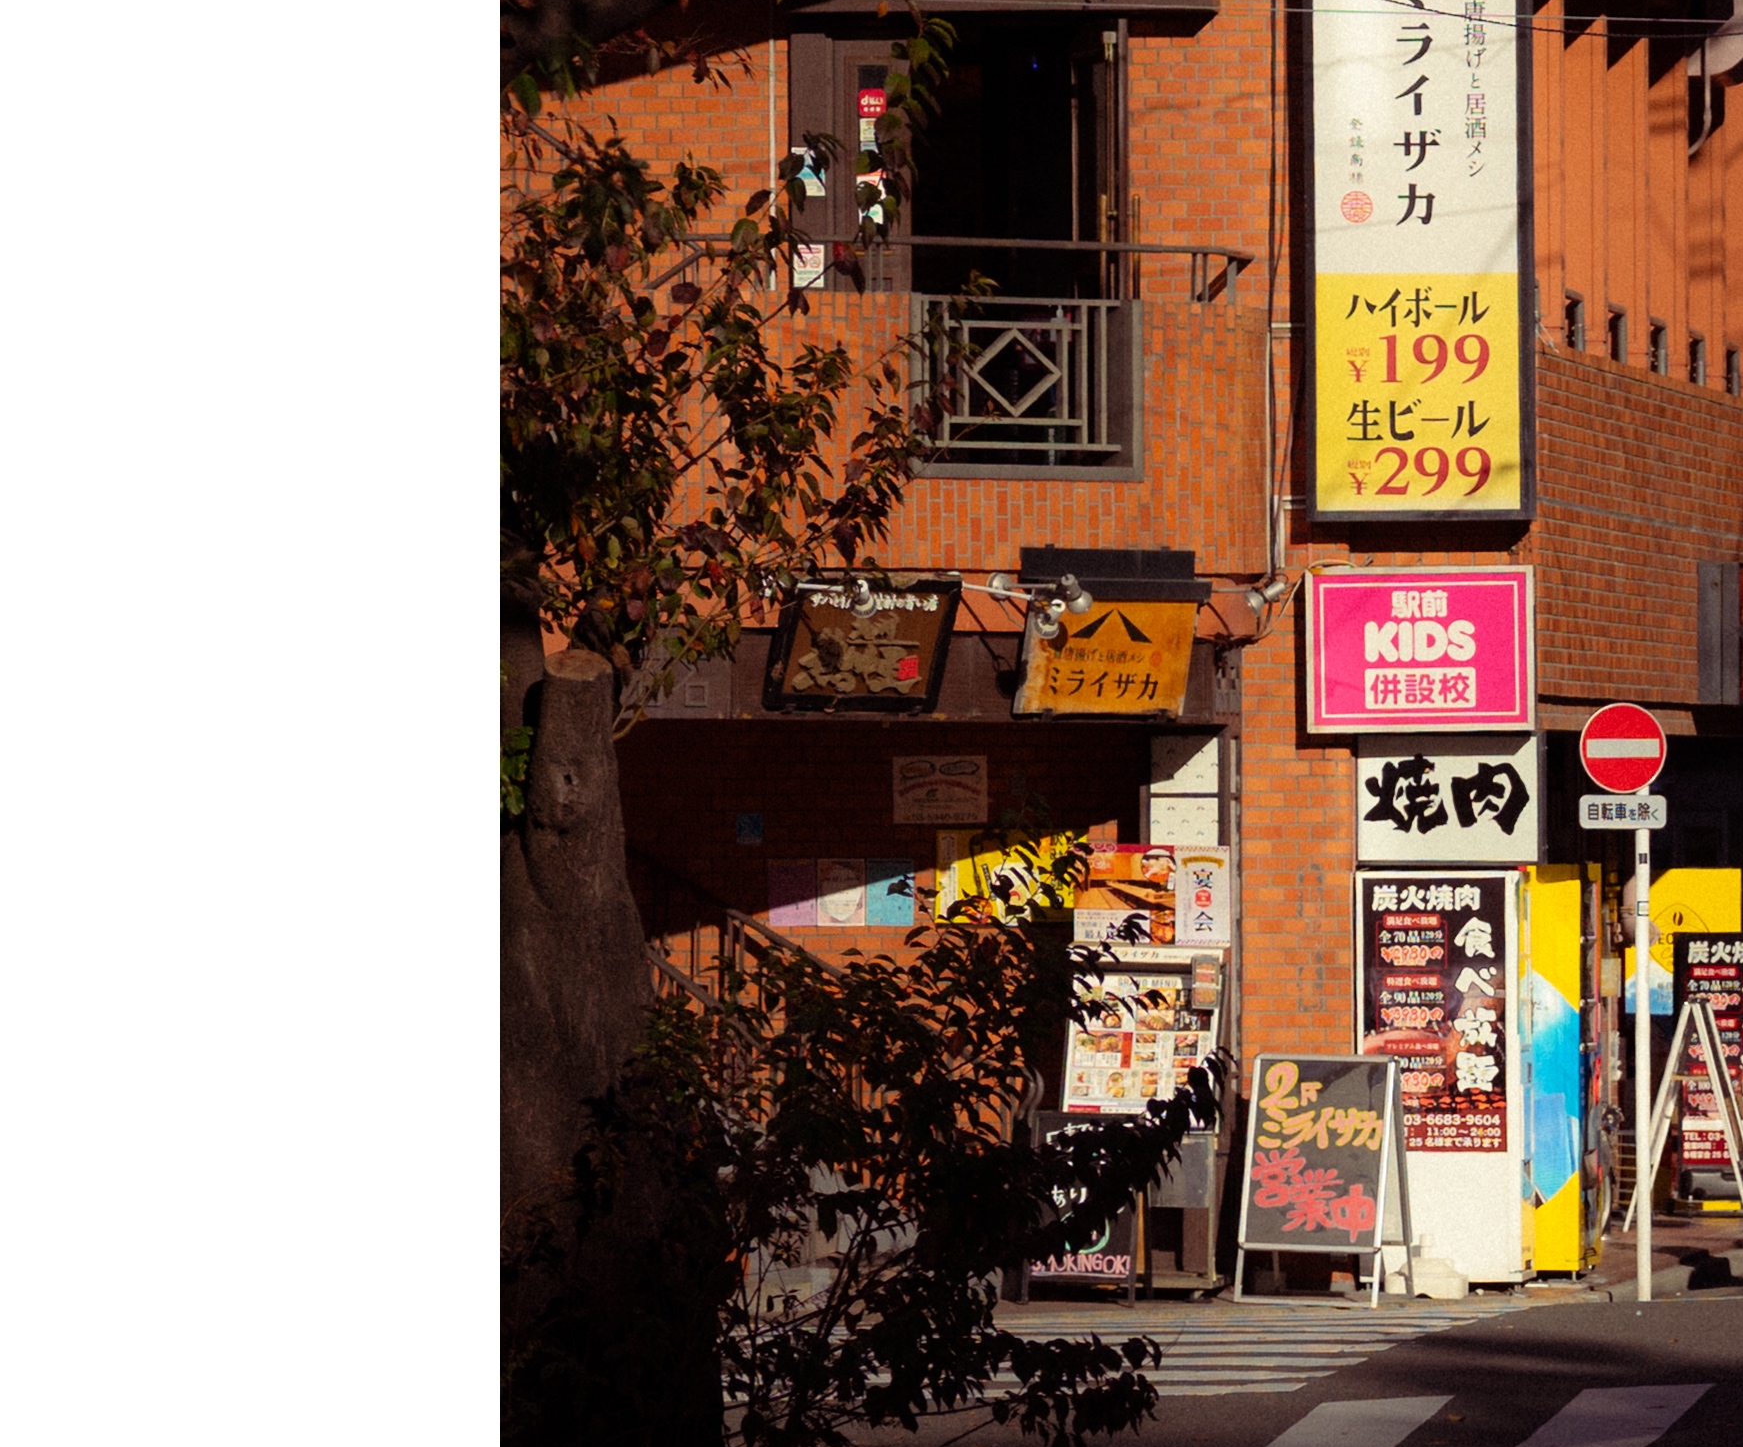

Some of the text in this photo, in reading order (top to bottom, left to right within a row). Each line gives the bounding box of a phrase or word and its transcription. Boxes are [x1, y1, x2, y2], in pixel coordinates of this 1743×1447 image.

[1345, 286, 1491, 328] ハイボール
[1347, 333, 1491, 385] ¥199
[1346, 398, 1491, 442] 生ビール
[1347, 446, 1493, 498] ¥299
[1390, 589, 1449, 619] 駅前
[1363, 619, 1477, 663] KIDS
[1048, 667, 1159, 701] ミライザカ
[1369, 672, 1472, 706] 併設校
[1363, 753, 1530, 836] 焼肉
[1587, 802, 1659, 822] 自転車を除く
[1371, 884, 1482, 912] 炭火焼肉
[1151, 978, 1178, 987] MENU
[1453, 916, 1500, 1093] 食べ放題
[1403, 1114, 1501, 1126] 03-6683-9604
[1251, 1147, 1377, 1244] 営業中
